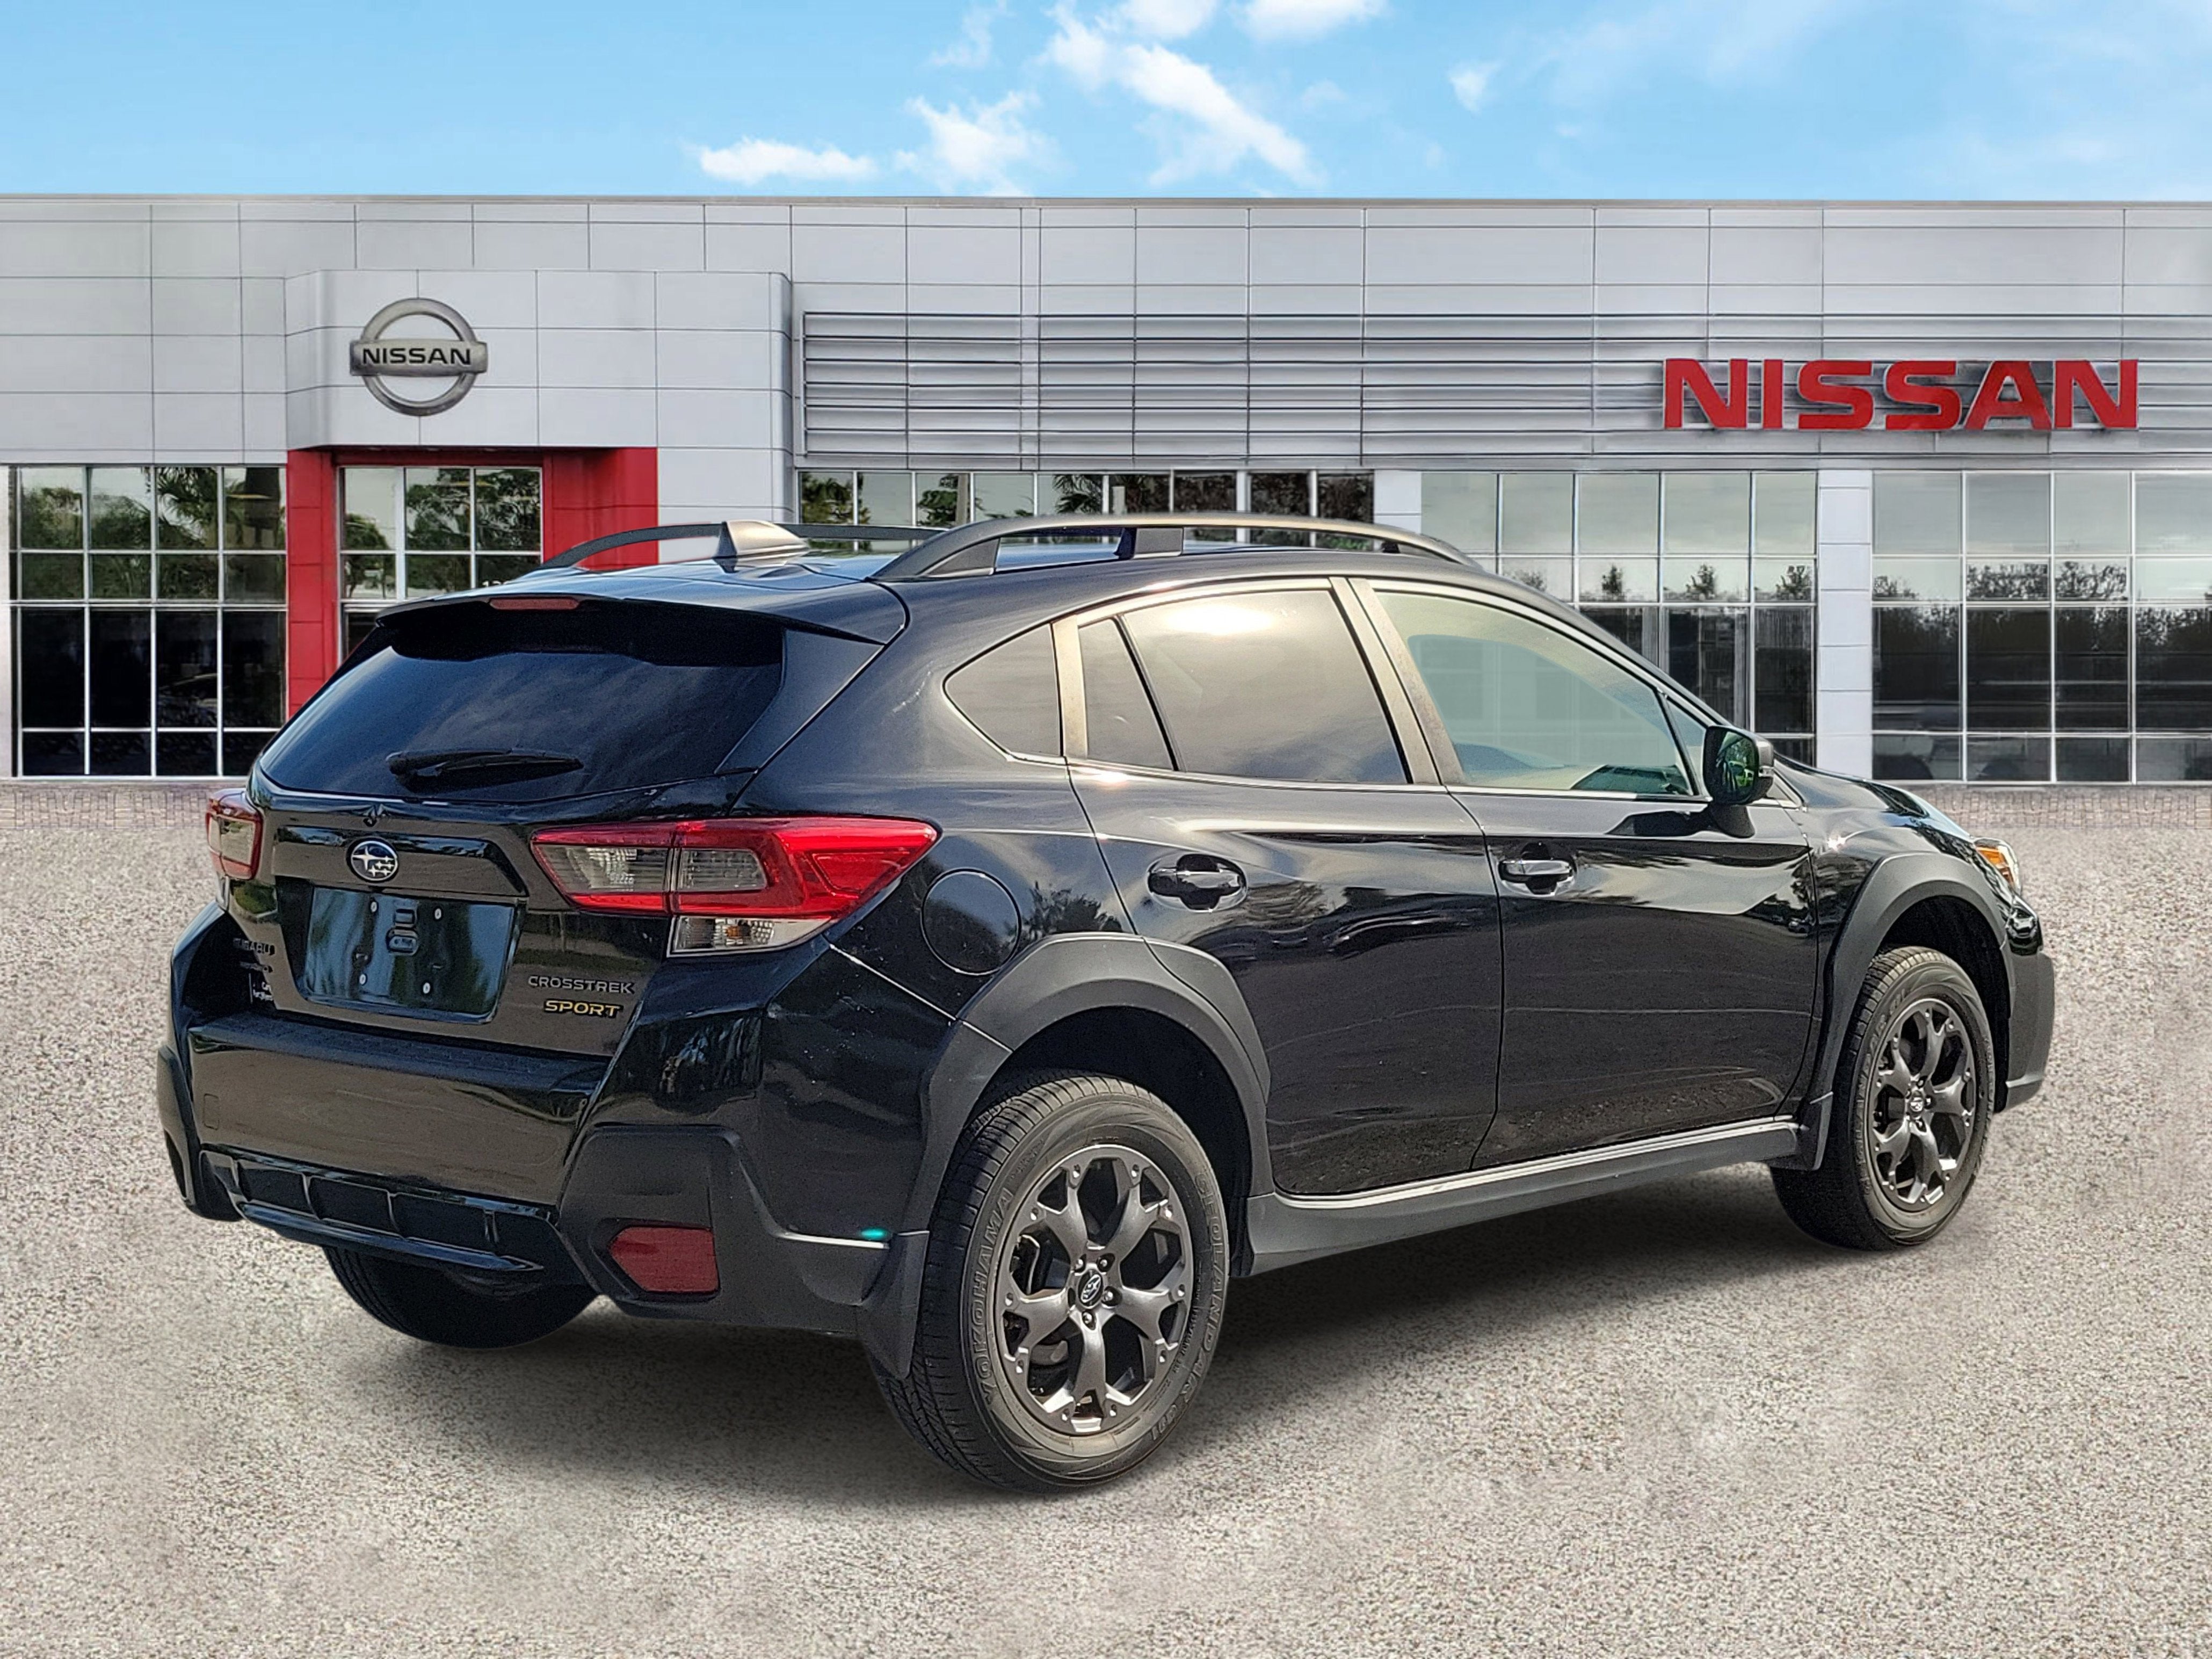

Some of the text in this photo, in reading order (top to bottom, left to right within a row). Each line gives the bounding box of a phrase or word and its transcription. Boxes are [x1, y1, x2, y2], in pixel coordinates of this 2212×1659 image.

[362, 347, 471, 365] NISSAN
[1663, 358, 2138, 430] NISSAN
[528, 975, 634, 994] CROSSTREK
[544, 999, 621, 1017] SPORT
[970, 1187, 1014, 1405] YOKOHAMA
